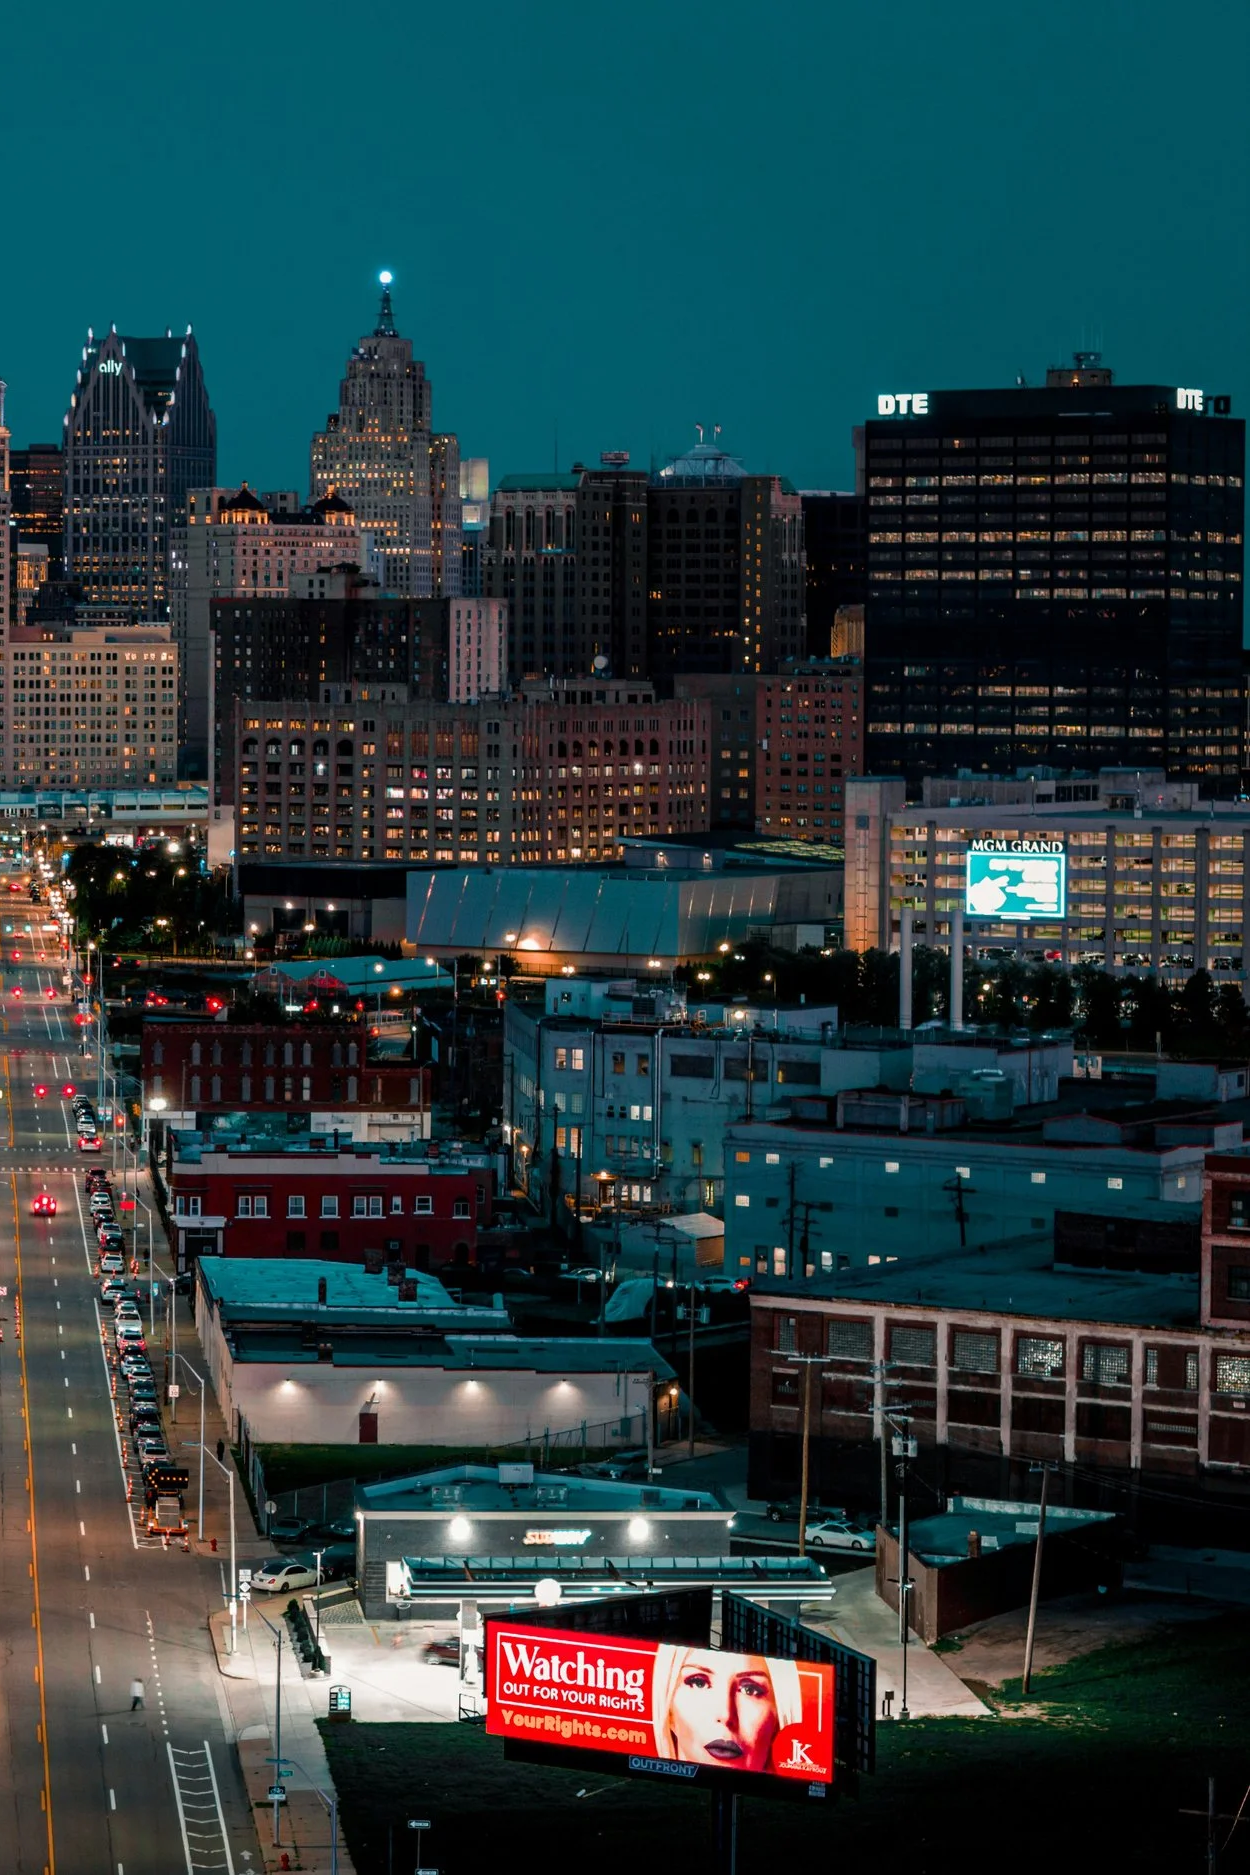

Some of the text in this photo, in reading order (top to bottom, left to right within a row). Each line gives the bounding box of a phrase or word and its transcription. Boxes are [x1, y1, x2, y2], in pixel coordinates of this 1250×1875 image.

[99, 360, 122, 376] ally
[878, 393, 928, 415] DTE
[1177, 388, 1203, 411] DTE
[972, 839, 1063, 853] MGM GRAND
[501, 1641, 645, 1702] Watching
[503, 1682, 645, 1712] OUT FOR YOUR RIGHTS
[501, 1709, 647, 1744] YourRights.com
[786, 1739, 814, 1764] JK
[632, 1757, 695, 1776] OUTFRONT
